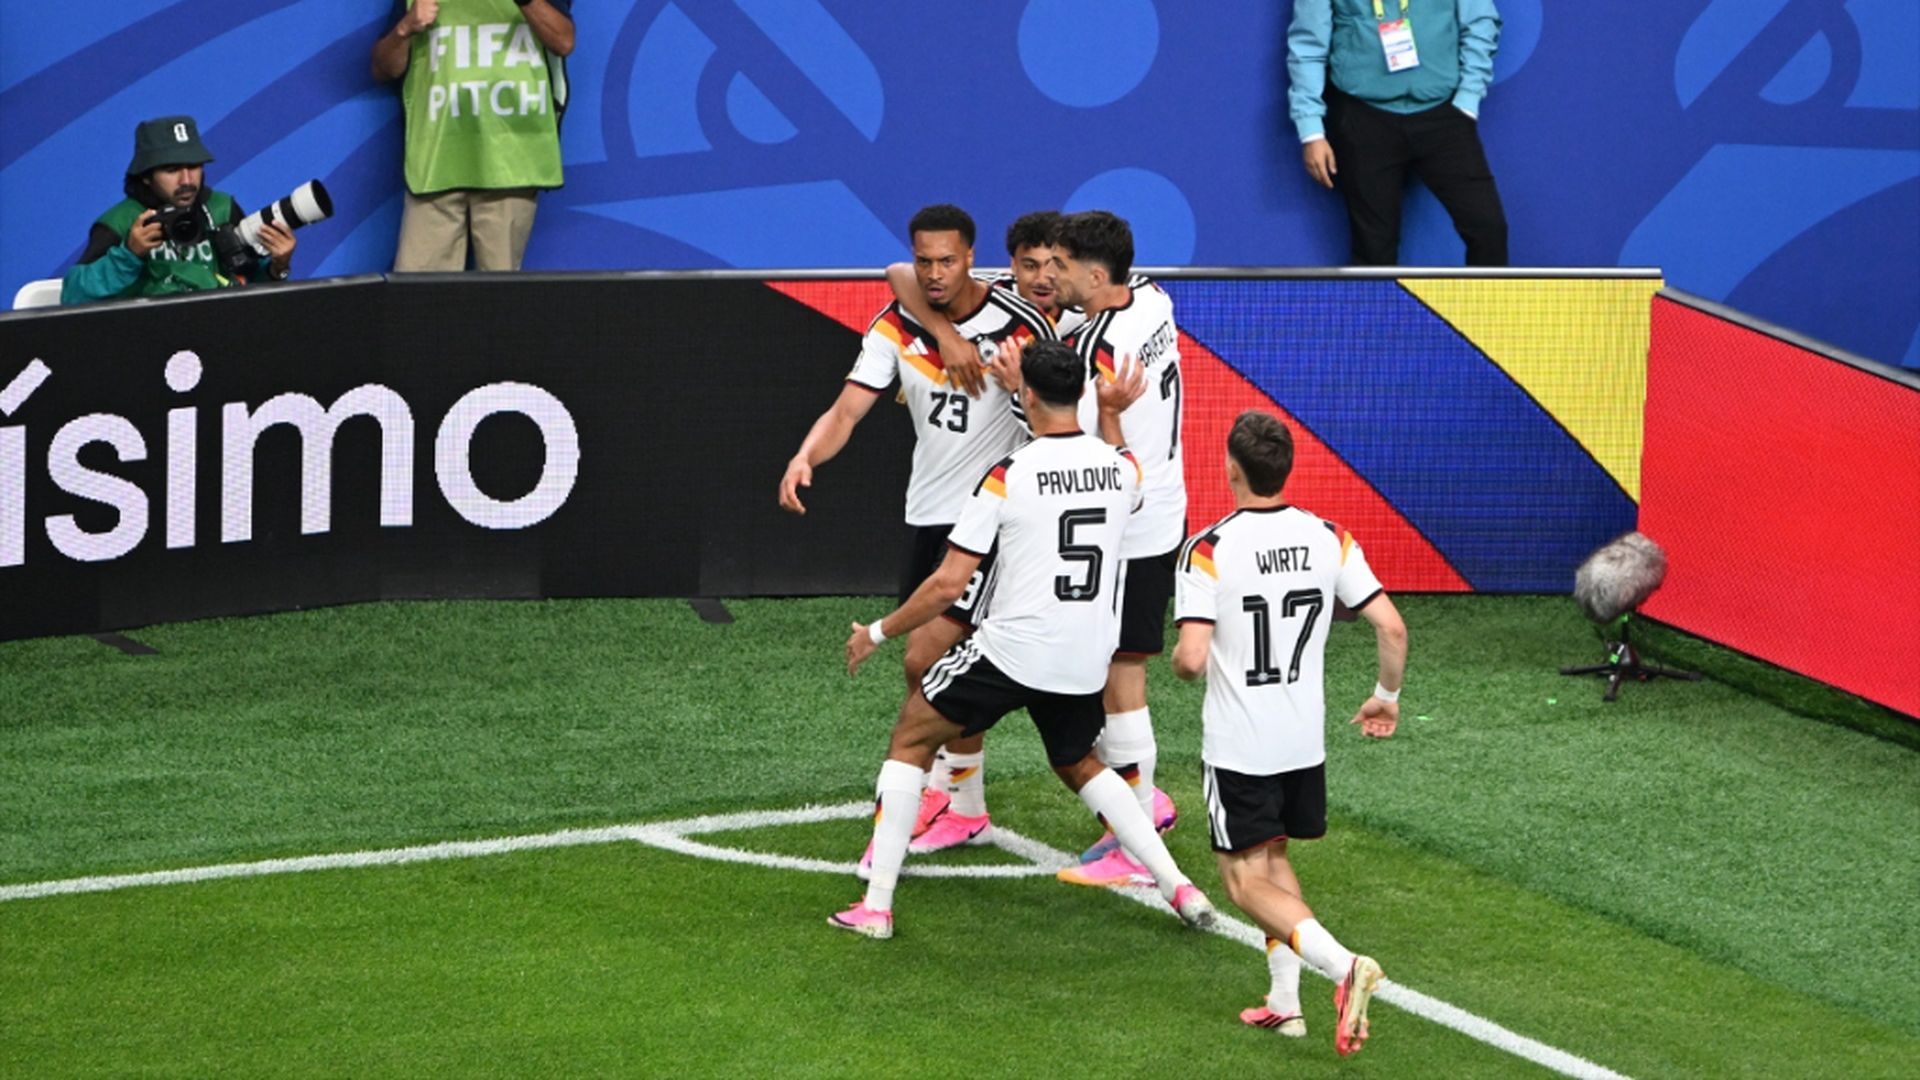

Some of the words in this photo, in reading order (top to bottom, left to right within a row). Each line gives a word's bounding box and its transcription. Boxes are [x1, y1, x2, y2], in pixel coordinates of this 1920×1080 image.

[428, 22, 544, 72] FIFA
[428, 79, 547, 122] PITCH
[928, 391, 969, 434] 23
[1160, 361, 1181, 461] 7
[0, 350, 581, 567] ísimo
[1055, 507, 1107, 601] 5
[1255, 546, 1312, 575] WIRTZ
[1242, 588, 1324, 687] 17
